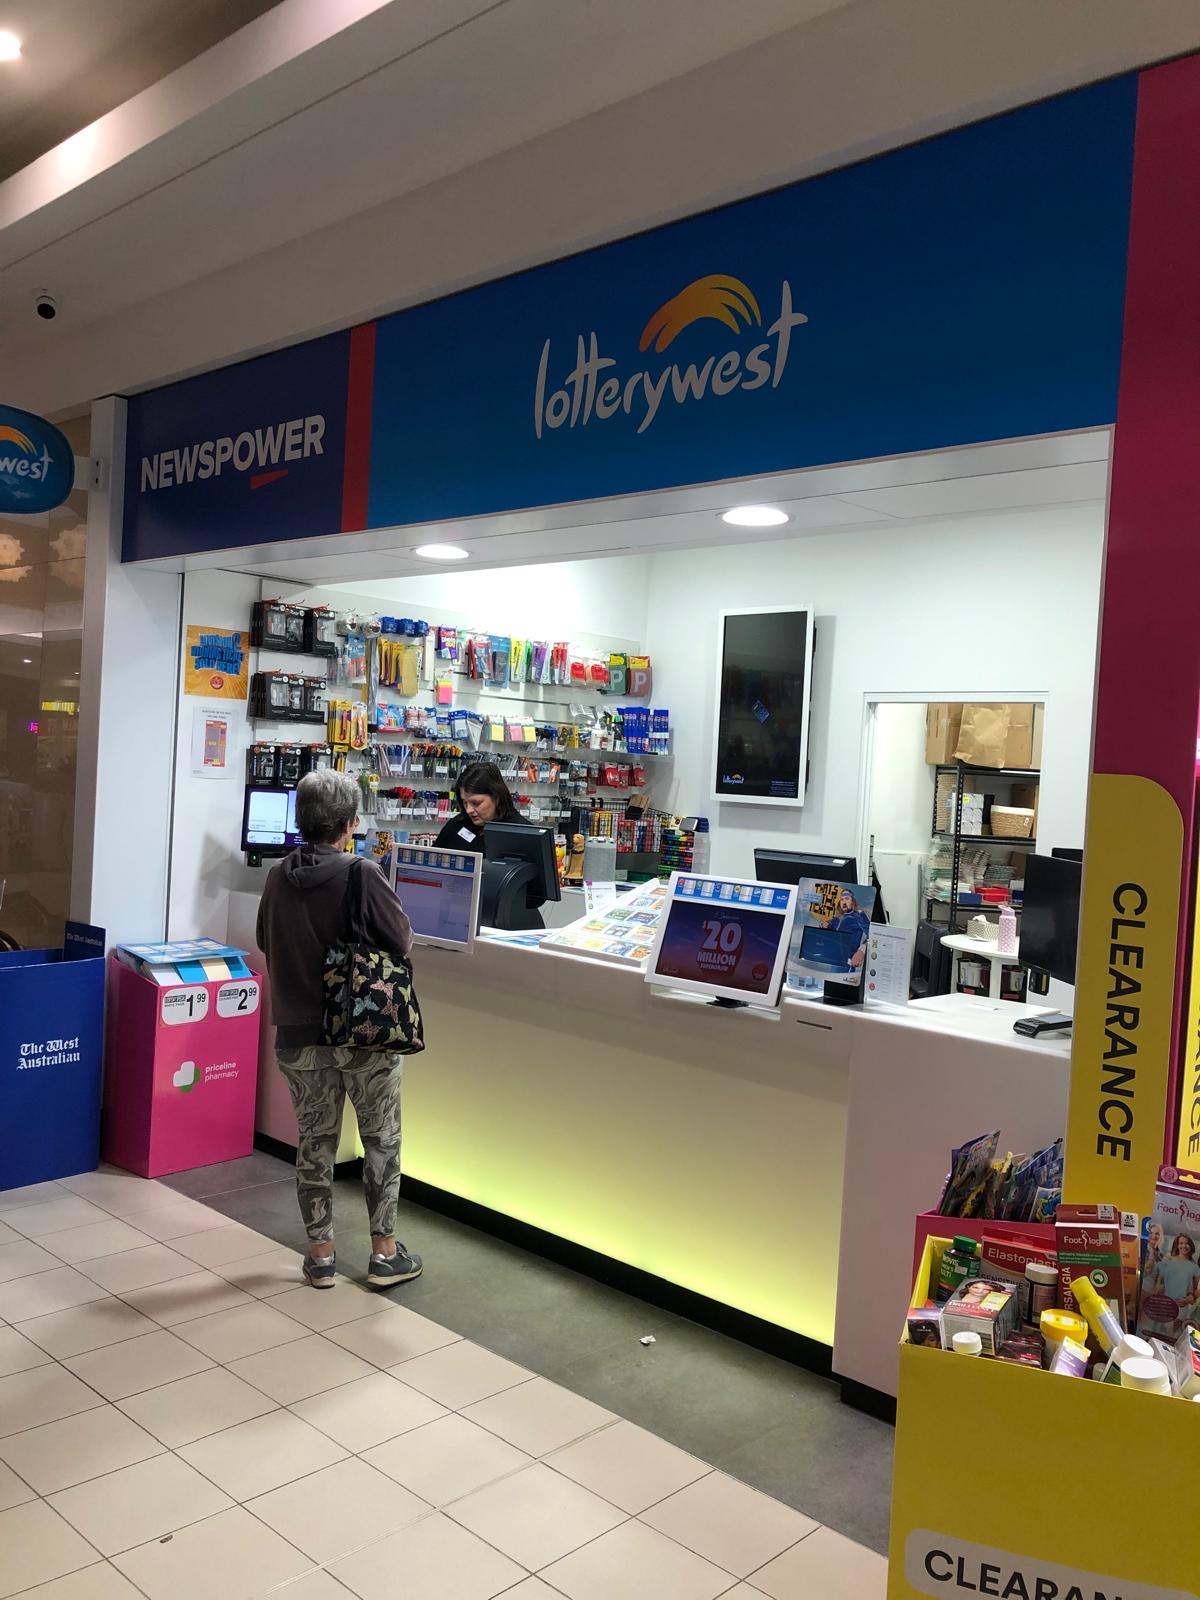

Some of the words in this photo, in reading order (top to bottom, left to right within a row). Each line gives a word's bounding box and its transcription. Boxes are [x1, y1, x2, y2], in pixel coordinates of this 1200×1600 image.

[535, 280, 809, 440] lotterywest
[141, 414, 326, 492] NEWSPOWER
[634, 672, 647, 693] P
[697, 951, 737, 966] MILLION
[1096, 883, 1148, 1162] CLEARANCE
[20, 1043, 44, 1056] The
[46, 1037, 79, 1052] West
[16, 1052, 80, 1070] Australian
[205, 1061, 237, 1074] priceline
[205, 1070, 239, 1084] pharmacy
[1157, 1202, 1178, 1215] Foot
[1063, 1236, 1083, 1244] Foot
[924, 1549, 1123, 1600] CLEARA
